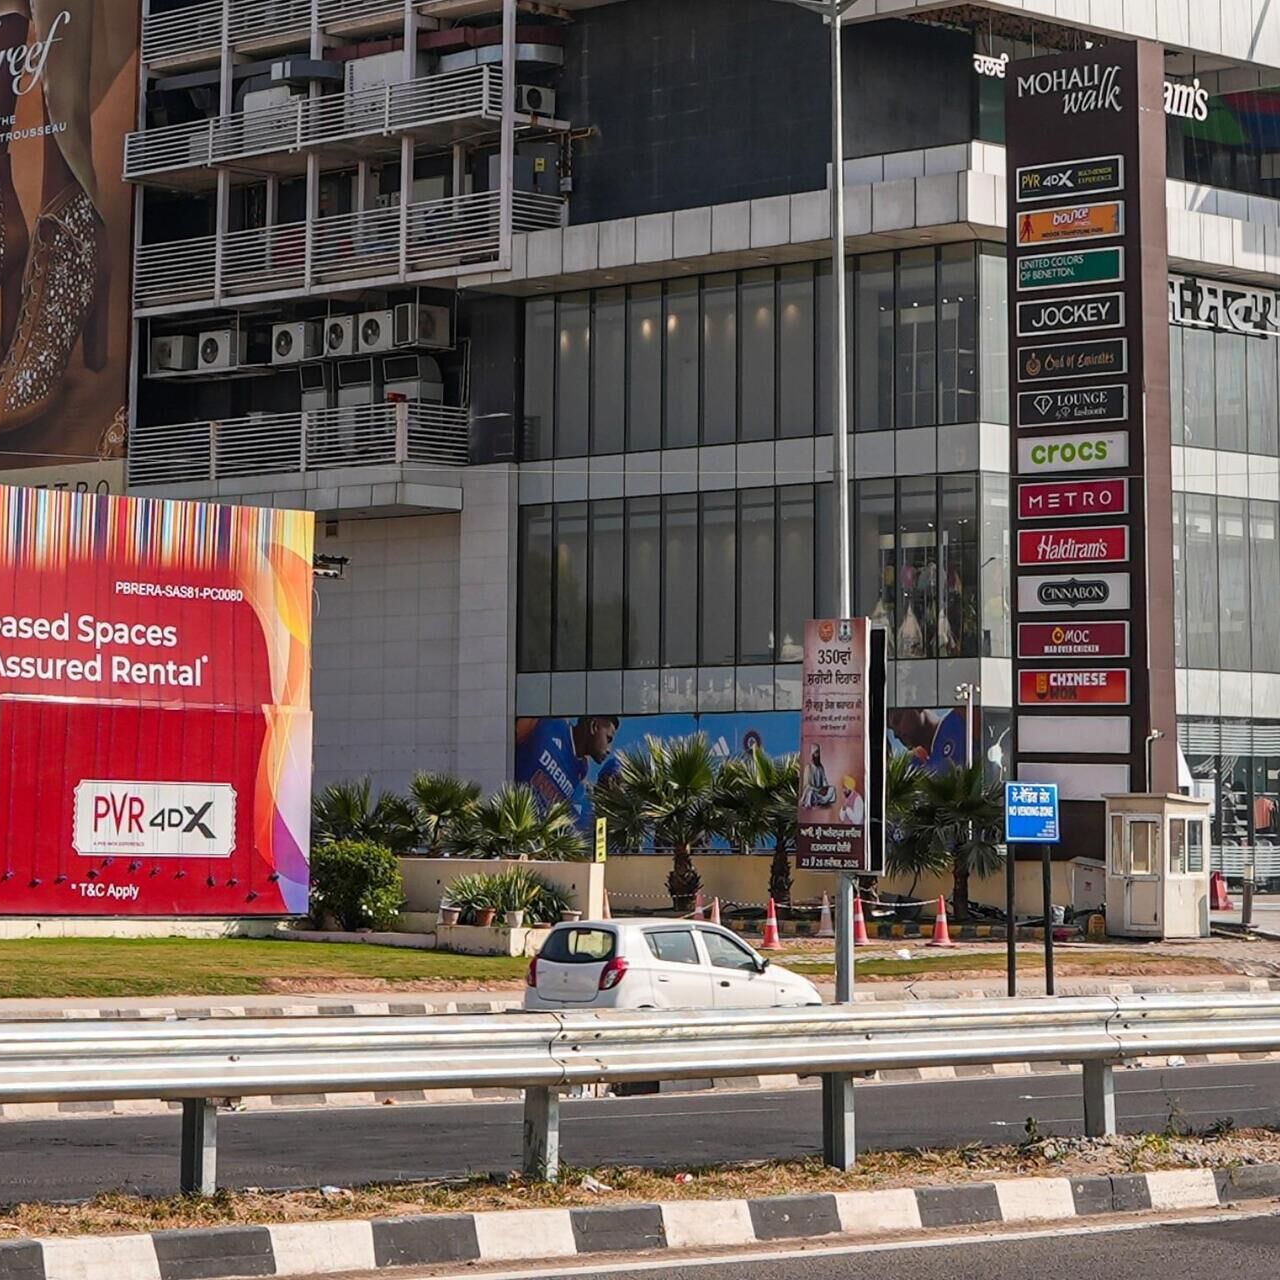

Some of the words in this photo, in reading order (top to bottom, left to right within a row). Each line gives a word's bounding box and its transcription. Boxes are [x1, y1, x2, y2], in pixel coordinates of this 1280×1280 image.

[1017, 64, 1099, 98] MOHALI
[1062, 64, 1124, 114] walk
[0, 122, 68, 143] TROUSSEAU
[1022, 173, 1040, 189] PVR
[1042, 169, 1075, 188] 4DX
[1053, 208, 1089, 226] bounce
[1020, 258, 1050, 270] UNITED
[1051, 255, 1085, 267] COLORS
[1020, 271, 1032, 281] OF
[1032, 302, 1111, 328] JOCKEY
[1066, 353, 1075, 369] of
[1076, 351, 1115, 369] Emirates
[1057, 391, 1108, 406] LOUNGE
[1031, 440, 1108, 465] crocs
[1029, 490, 1112, 509] METRO
[1037, 535, 1108, 560] Haldiram's
[1042, 586, 1105, 600] CINNABON
[77, 614, 178, 653] Spaces
[1064, 630, 1090, 643] MOC
[1044, 645, 1057, 653] MAD
[1058, 645, 1072, 653] OVER
[1073, 645, 1100, 653] CHICKEN
[1049, 673, 1107, 687] CHINESE
[1050, 686, 1077, 700] WOK
[93, 791, 145, 836] PVR
[149, 801, 217, 839] 4DX
[79, 883, 105, 897] T&C
[107, 883, 140, 900] Apply
